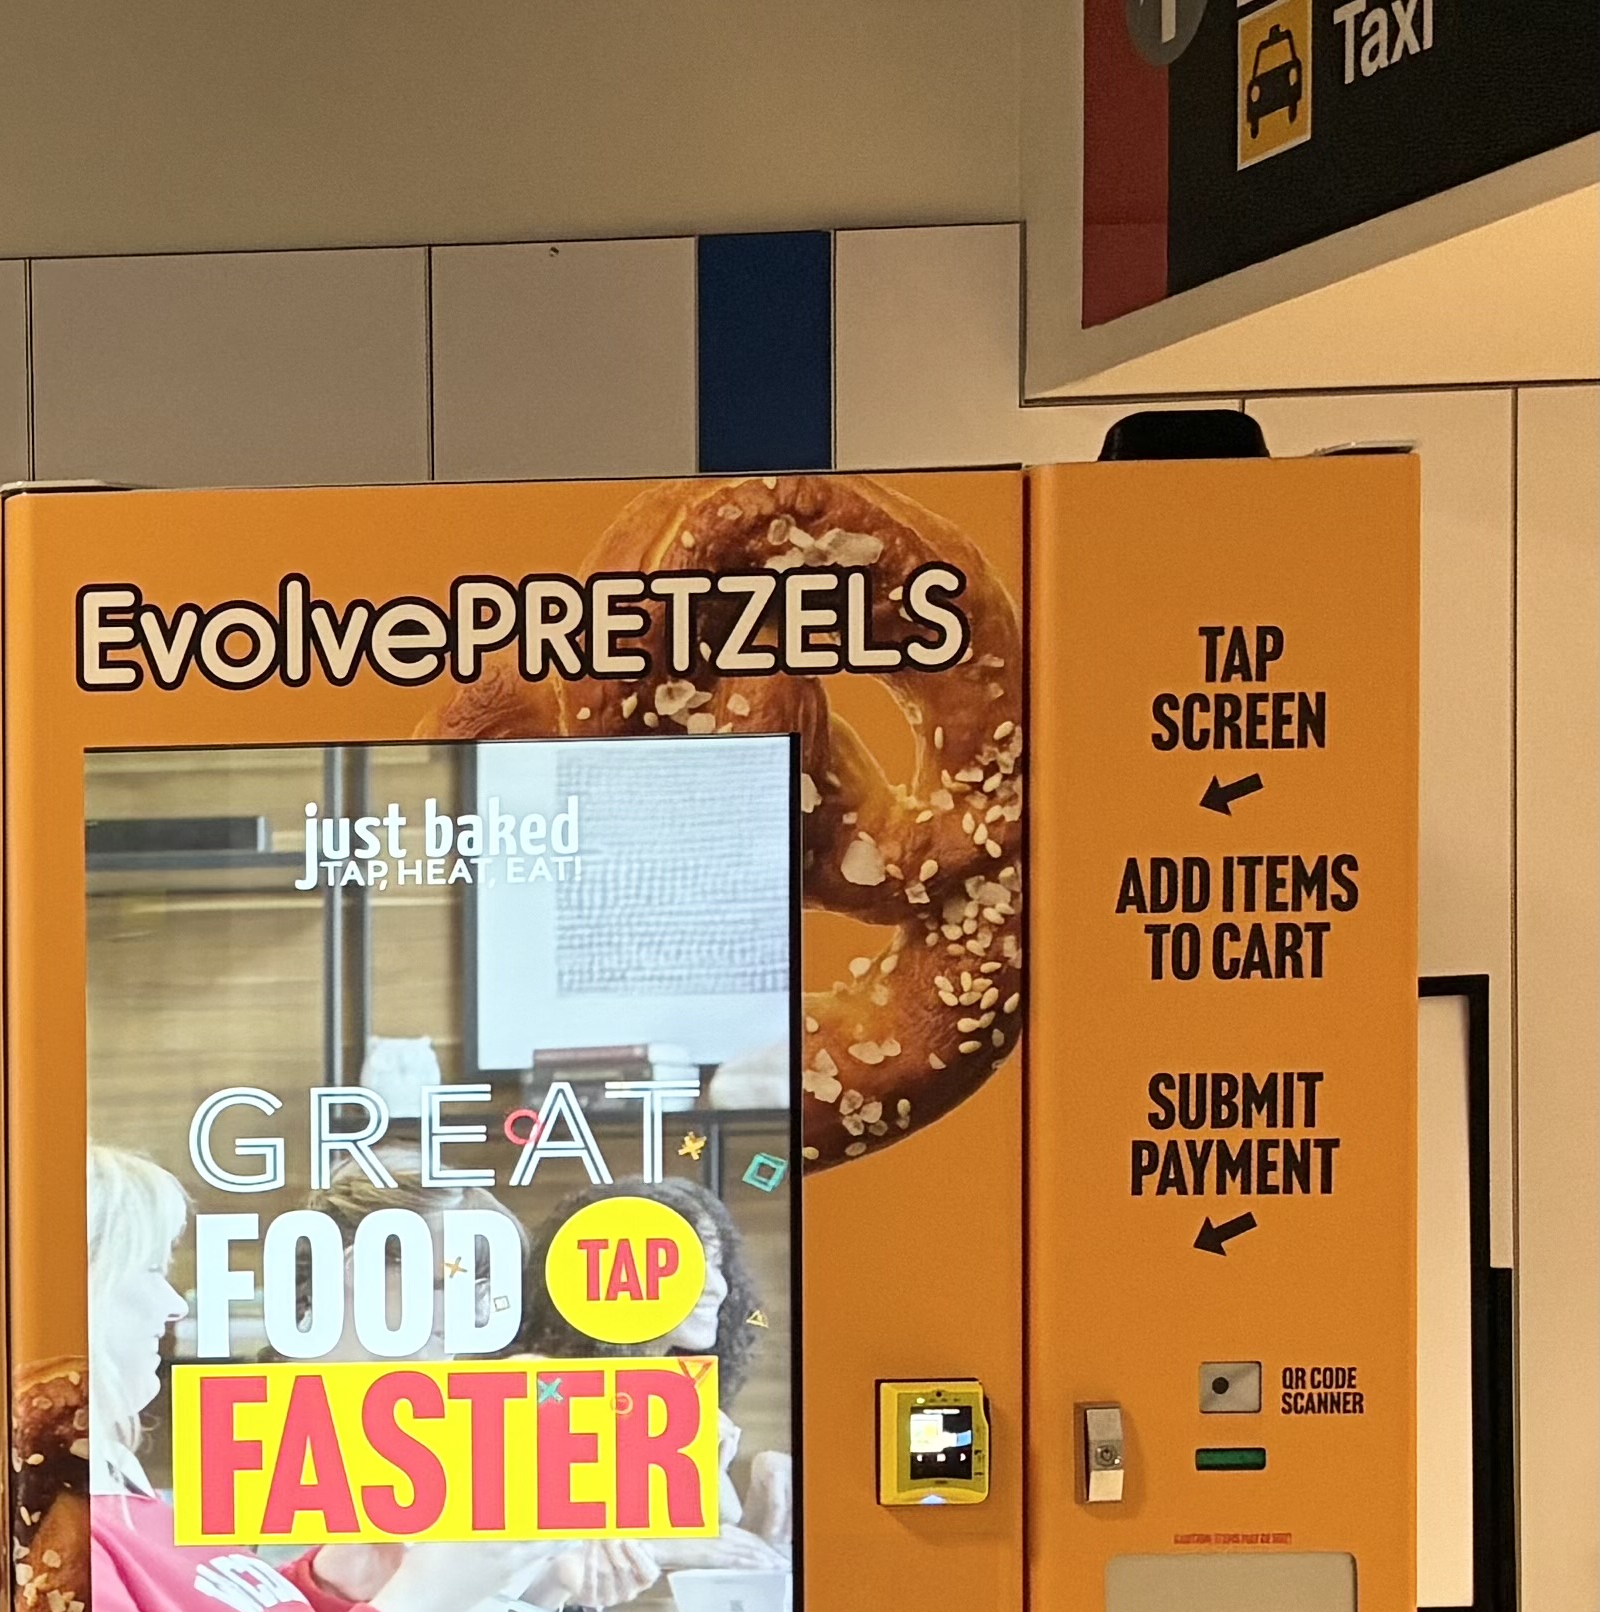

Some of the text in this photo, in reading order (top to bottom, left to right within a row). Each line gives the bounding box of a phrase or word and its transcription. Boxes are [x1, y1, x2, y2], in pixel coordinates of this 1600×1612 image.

[1333, 0, 1433, 85] Taxi
[76, 563, 971, 695] EvolvePRETZELS
[1199, 626, 1284, 683] TAP
[1152, 691, 1327, 750] SCREEN
[294, 797, 580, 891] just baked
[1115, 854, 1359, 914] ADD ITEMS
[1144, 922, 1331, 980] TO CART
[1147, 1071, 1324, 1130] SUBMIT
[188, 1081, 700, 1193] GREAT
[1130, 1138, 1340, 1196] PAYMENT
[196, 1208, 522, 1359] FOOD
[577, 1237, 680, 1301] TAP
[1282, 1367, 1357, 1391] QR CODE
[1282, 1391, 1365, 1414] SCANNER
[198, 1368, 705, 1536] FASTER
